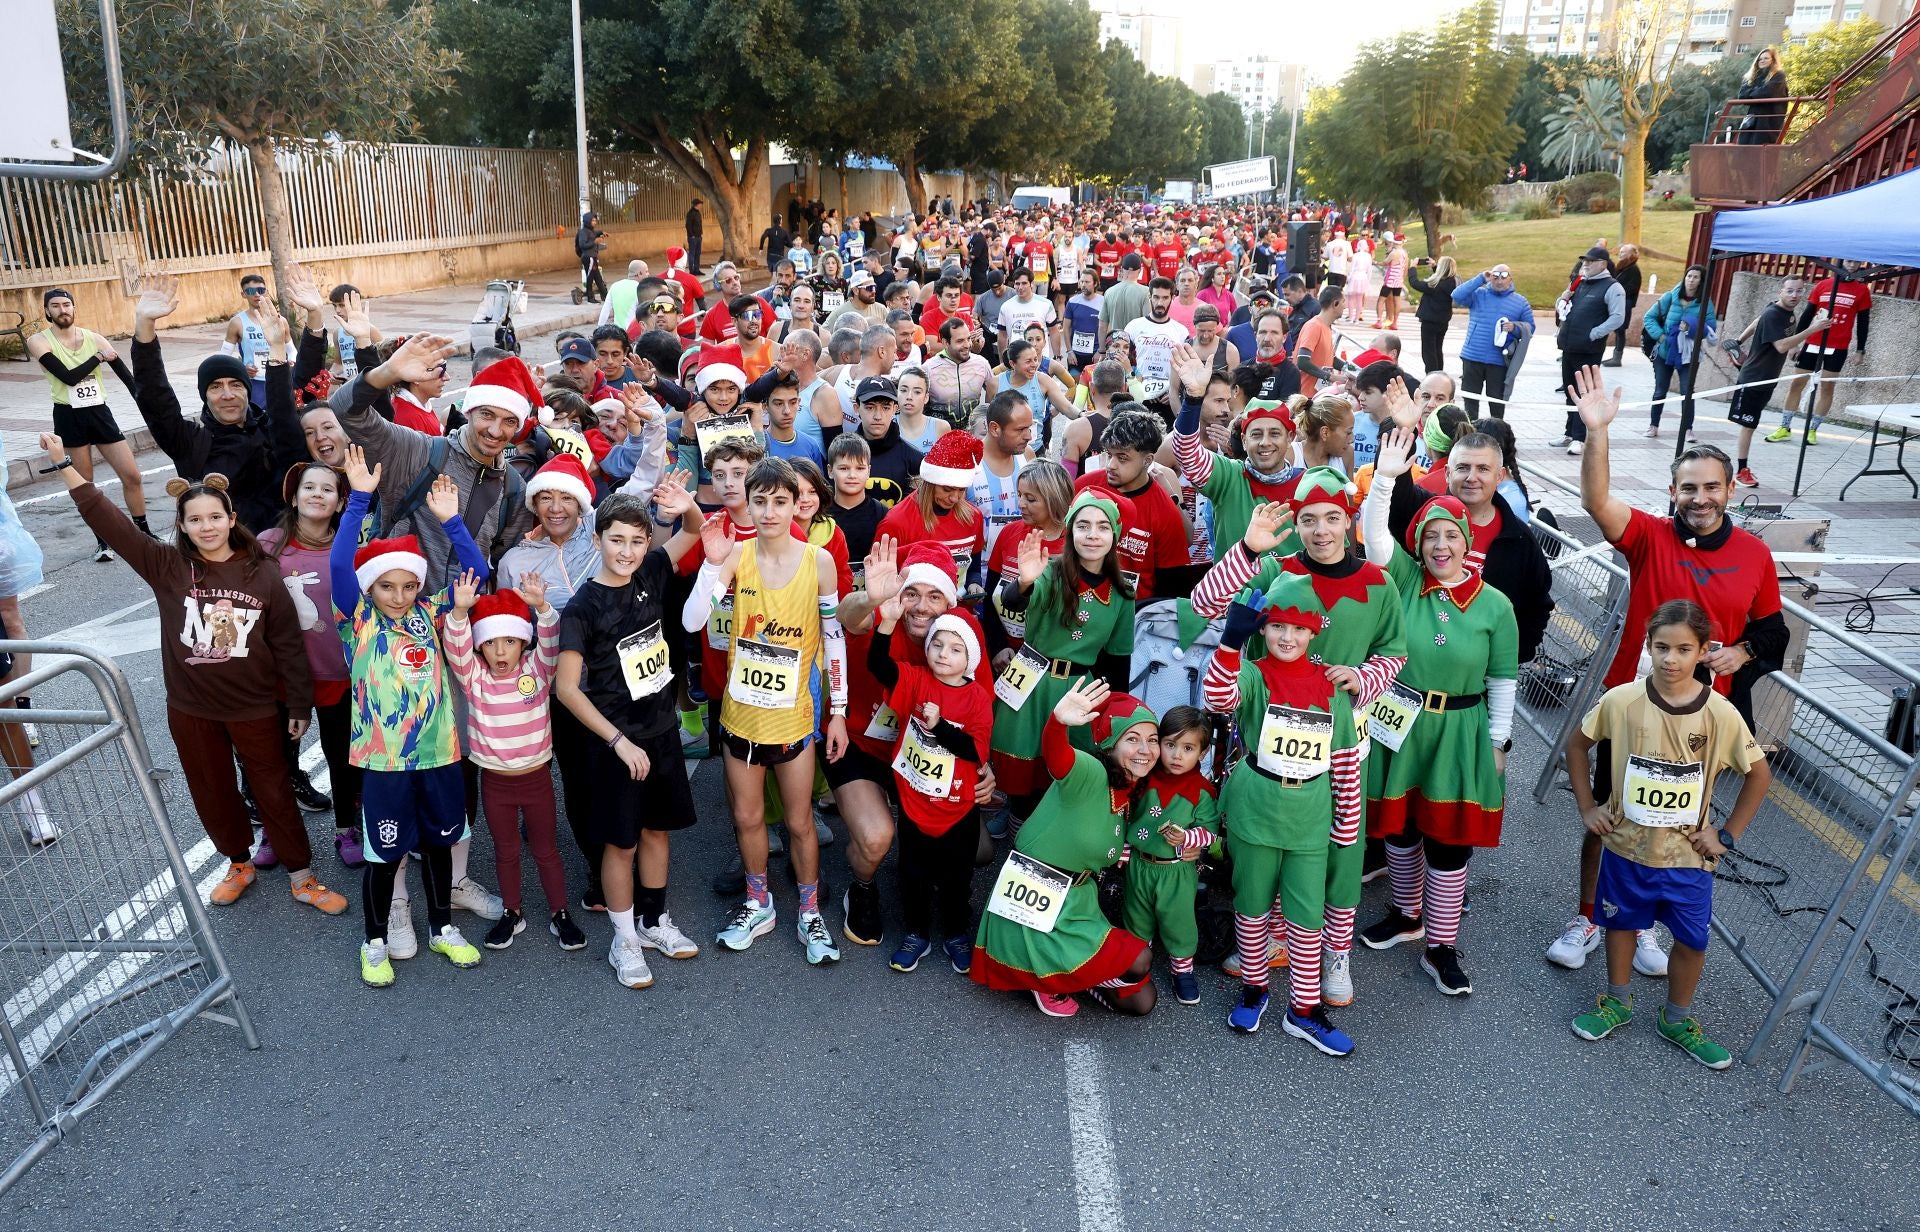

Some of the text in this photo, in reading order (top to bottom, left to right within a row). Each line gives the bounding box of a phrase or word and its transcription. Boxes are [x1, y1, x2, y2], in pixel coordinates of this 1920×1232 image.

[1227, 175, 1269, 187] FEDERADOS
[1075, 339, 1090, 348] 532
[76, 386, 98, 400] 825
[1143, 382, 1165, 393] 679
[190, 588, 263, 609] WILLIAMSBURG
[180, 596, 262, 659] NY
[762, 618, 804, 638] Álora
[635, 649, 665, 680] 1040
[741, 667, 787, 691] 1025
[1370, 701, 1405, 730] 1034
[1272, 736, 1322, 760] 1021
[906, 746, 944, 780] 1024
[1635, 787, 1691, 809] 1020
[1003, 880, 1051, 912] 1009
